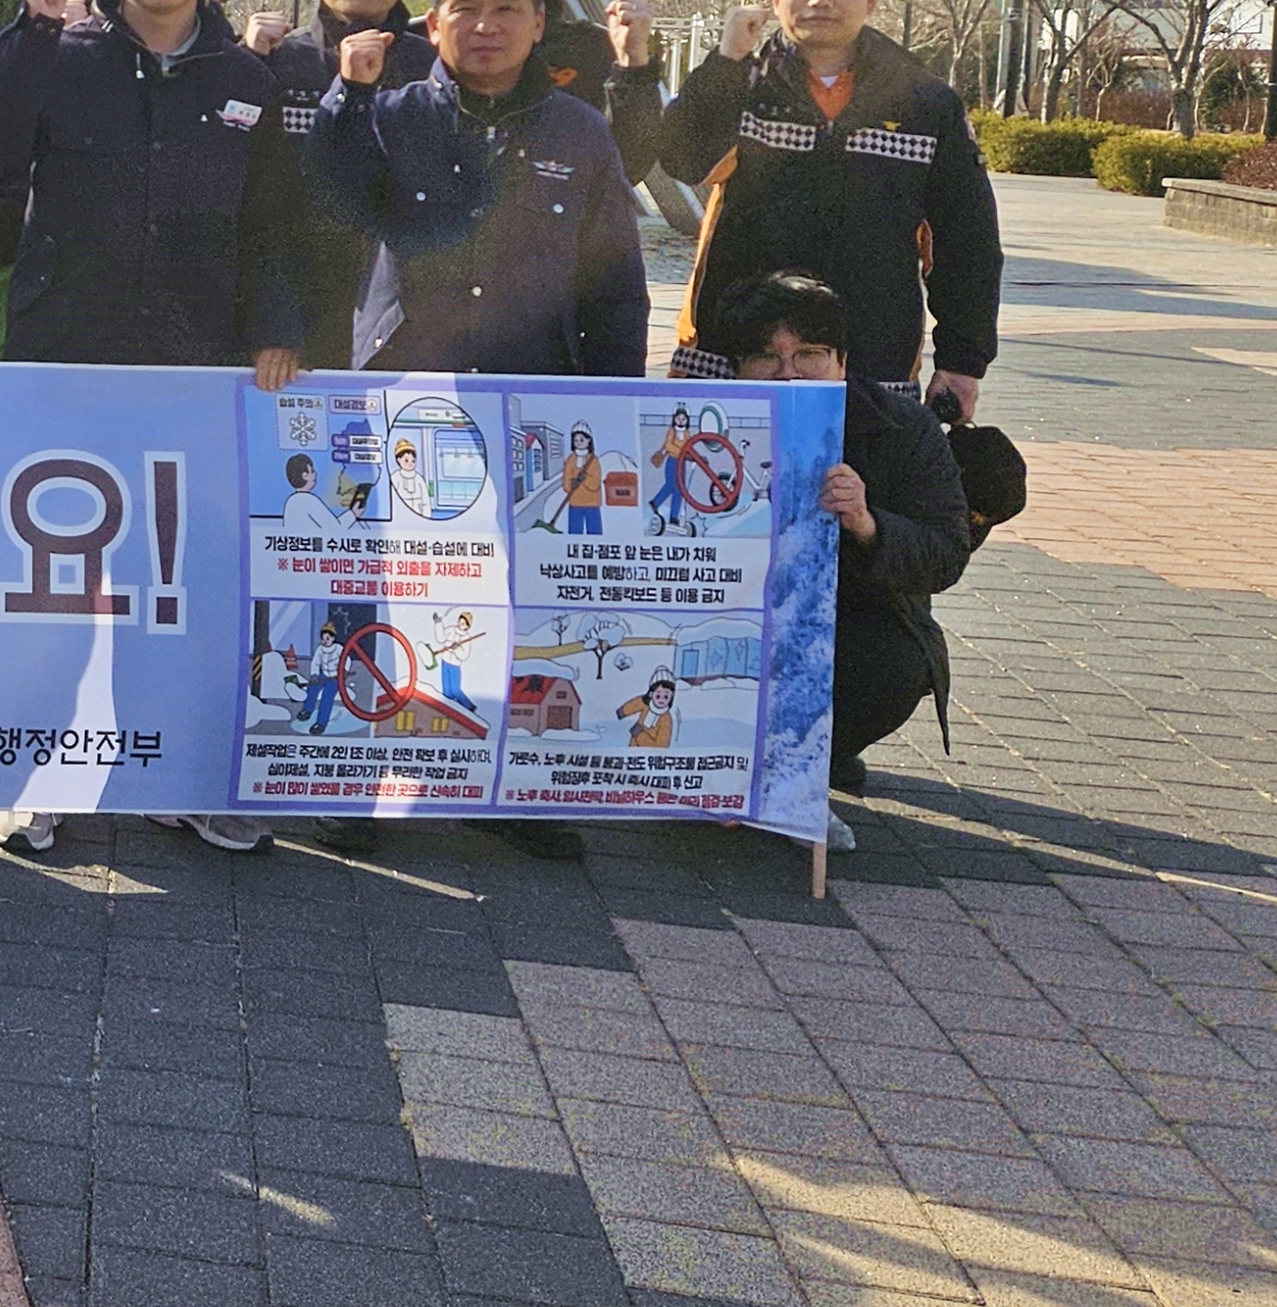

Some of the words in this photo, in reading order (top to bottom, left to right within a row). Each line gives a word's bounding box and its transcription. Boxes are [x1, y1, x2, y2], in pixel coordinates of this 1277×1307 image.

[264, 536, 323, 553] 기상정보를
[326, 538, 364, 554] 수시로
[365, 539, 402, 555] 확인해
[471, 542, 495, 557] 대비
[567, 544, 579, 559] 내
[625, 545, 636, 560] 앞
[639, 546, 663, 561] 눈은
[666, 546, 690, 562] 내가
[693, 547, 717, 563] 치워
[292, 558, 316, 573] 눈이
[319, 559, 354, 574] 쌓이면
[358, 560, 393, 575] 가급적
[396, 561, 431, 576] 외출을
[435, 562, 482, 578] 자제하고
[540, 564, 598, 580] 낙상사고를
[655, 567, 689, 582] 미끄럼
[693, 567, 716, 582] 사고
[719, 568, 742, 583] 대비
[330, 580, 377, 596] 대중교통
[381, 581, 428, 597] 이용하기
[599, 586, 657, 602] 전동킥보드
[661, 587, 672, 603] 등
[675, 588, 698, 603] 이용
[701, 588, 725, 603] 금지
[246, 743, 297, 758] 제설작업은
[265, 781, 286, 795] 눈이
